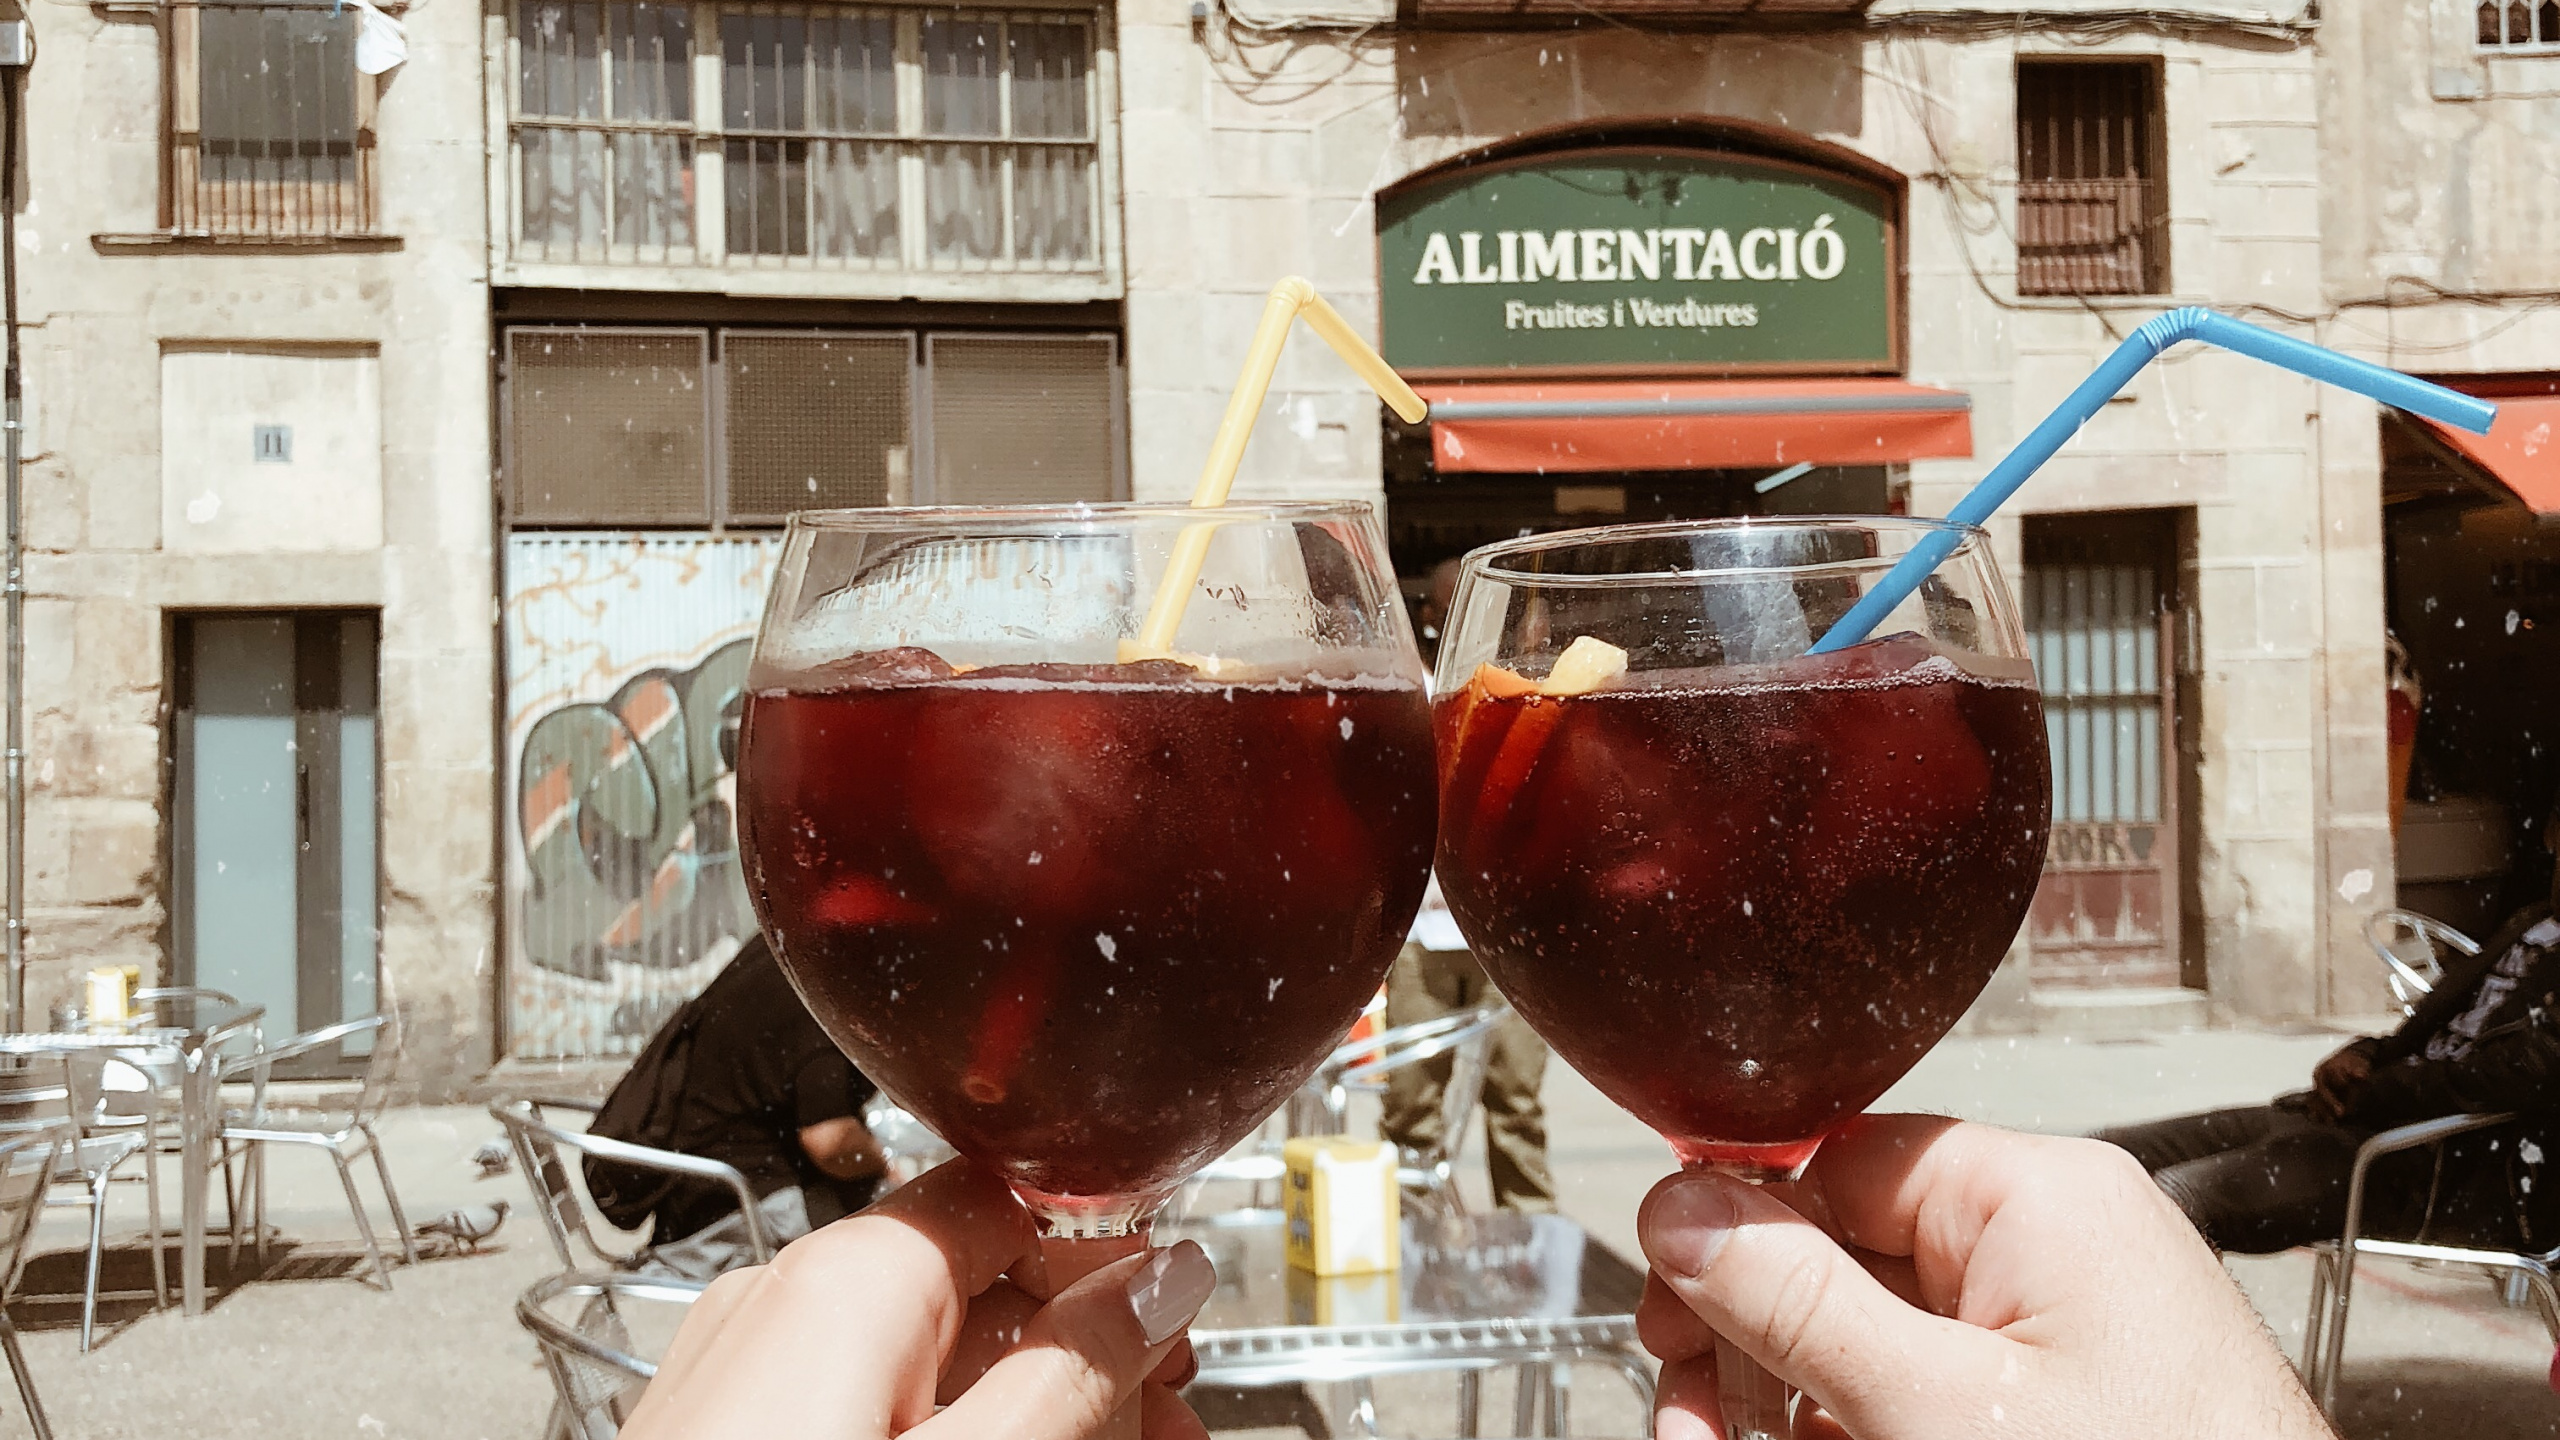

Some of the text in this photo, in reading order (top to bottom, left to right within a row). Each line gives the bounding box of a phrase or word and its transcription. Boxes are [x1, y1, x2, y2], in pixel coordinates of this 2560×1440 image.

[1412, 214, 1846, 284] ALIMENTACIÓ
[1505, 296, 1759, 329] Fruites i Verdures
